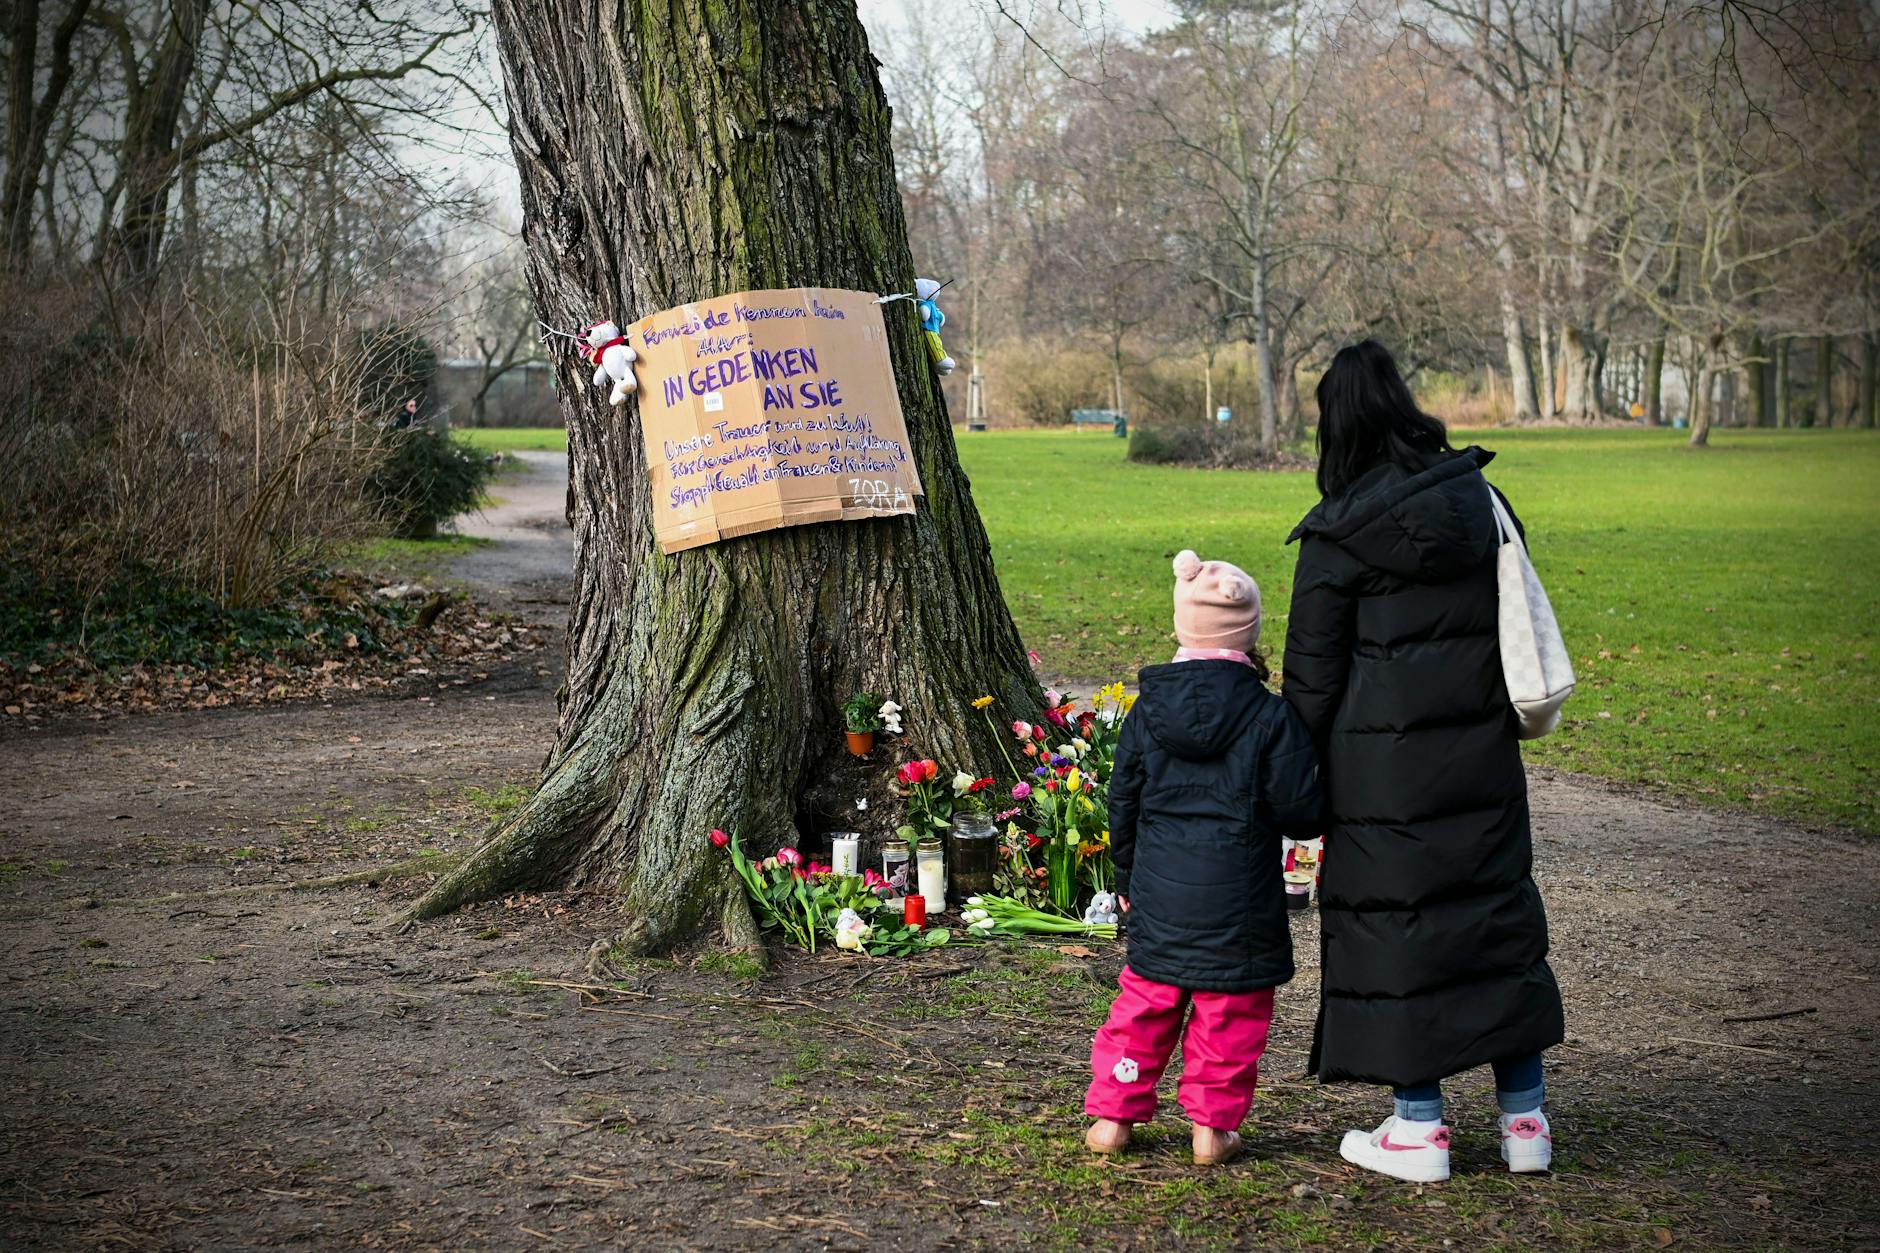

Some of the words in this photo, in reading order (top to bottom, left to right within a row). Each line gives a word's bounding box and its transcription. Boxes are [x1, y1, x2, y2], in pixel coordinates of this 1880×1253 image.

[663, 374, 684, 408] IN
[688, 346, 819, 396] GEDENKEN
[763, 383, 794, 411] AN
[800, 379, 842, 409] SIE
[664, 433, 714, 461] Unsere
[712, 420, 772, 443] Trauer
[775, 418, 804, 433] wird
[806, 420, 828, 432] zu
[806, 435, 842, 454] und
[778, 459, 829, 479] Frauen
[828, 455, 843, 473] &
[848, 478, 913, 513] ZORA
